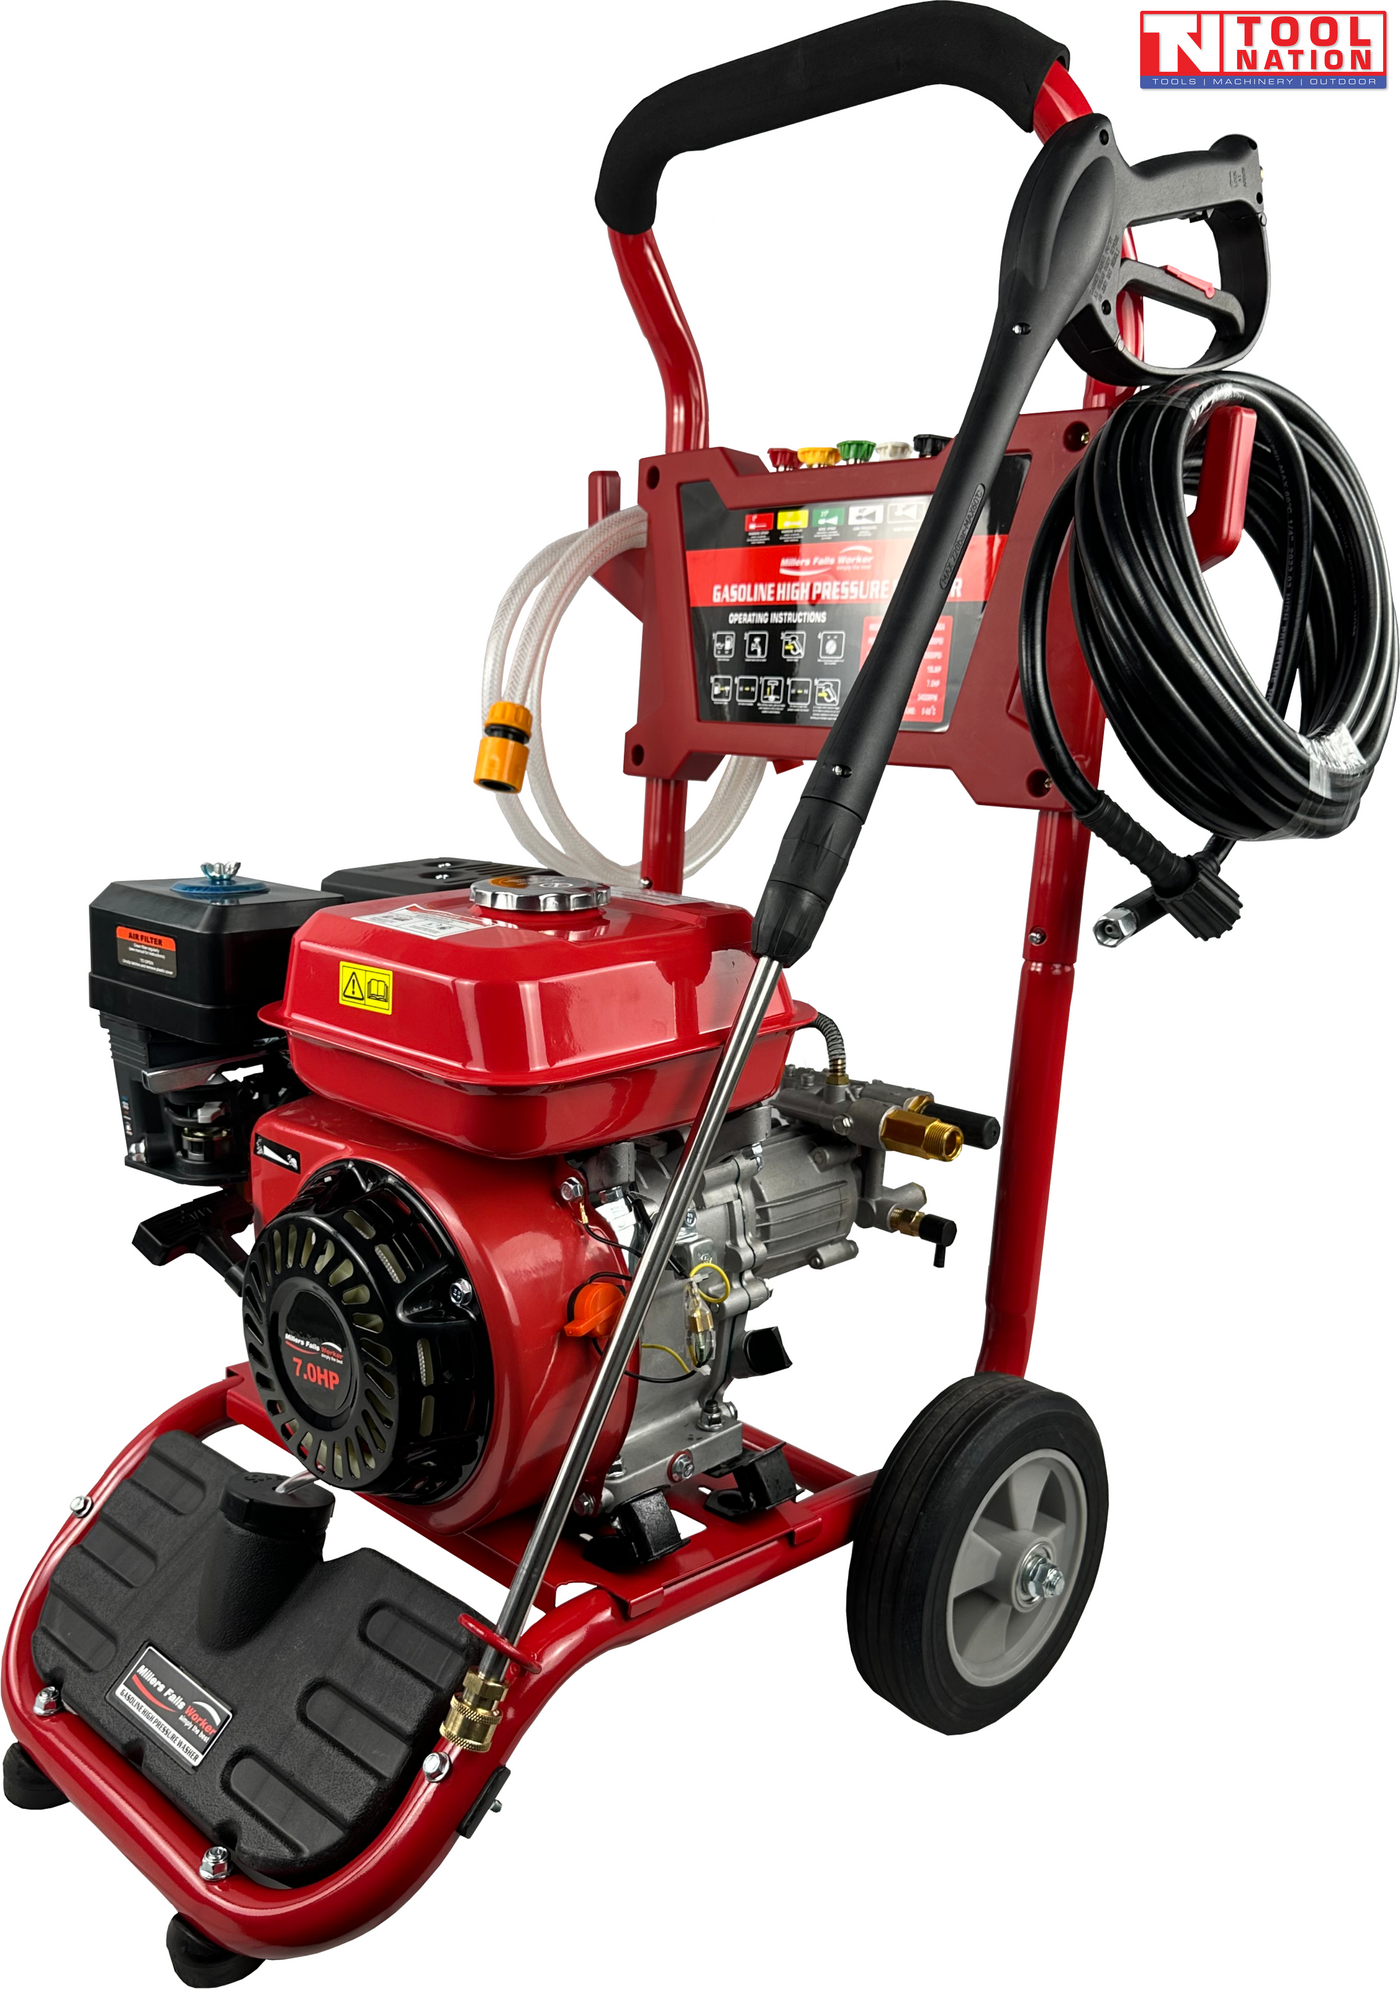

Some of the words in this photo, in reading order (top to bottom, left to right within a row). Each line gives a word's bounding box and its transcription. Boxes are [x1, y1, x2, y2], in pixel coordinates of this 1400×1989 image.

[780, 556, 810, 567] Millers
[812, 555, 835, 566] Falls
[837, 554, 874, 565] Worker
[712, 582, 775, 603] GASOLINE
[776, 582, 811, 602] HIGH
[812, 579, 889, 601] PRESSURE
[728, 612, 769, 624] OPERATING
[770, 611, 827, 624] INSTRUCTIONS
[1283, 592, 1291, 621] HIGH
[128, 932, 139, 942] AIR
[140, 935, 163, 946] FILTER
[285, 1333, 304, 1346] Millers
[306, 1341, 320, 1352] Falls
[321, 1346, 344, 1360] Worker
[292, 1356, 340, 1391] 7.0HP
[136, 1664, 166, 1693] Millers
[163, 1688, 186, 1710] Falls
[184, 1705, 217, 1736] Worker
[119, 1688, 144, 1713] GASOLINE
[141, 1708, 155, 1725] HIGH
[153, 1717, 179, 1745] PRESSURE
[176, 1738, 200, 1763] WASHER
[178, 1714, 193, 1731] simply
[191, 1724, 200, 1735] the
